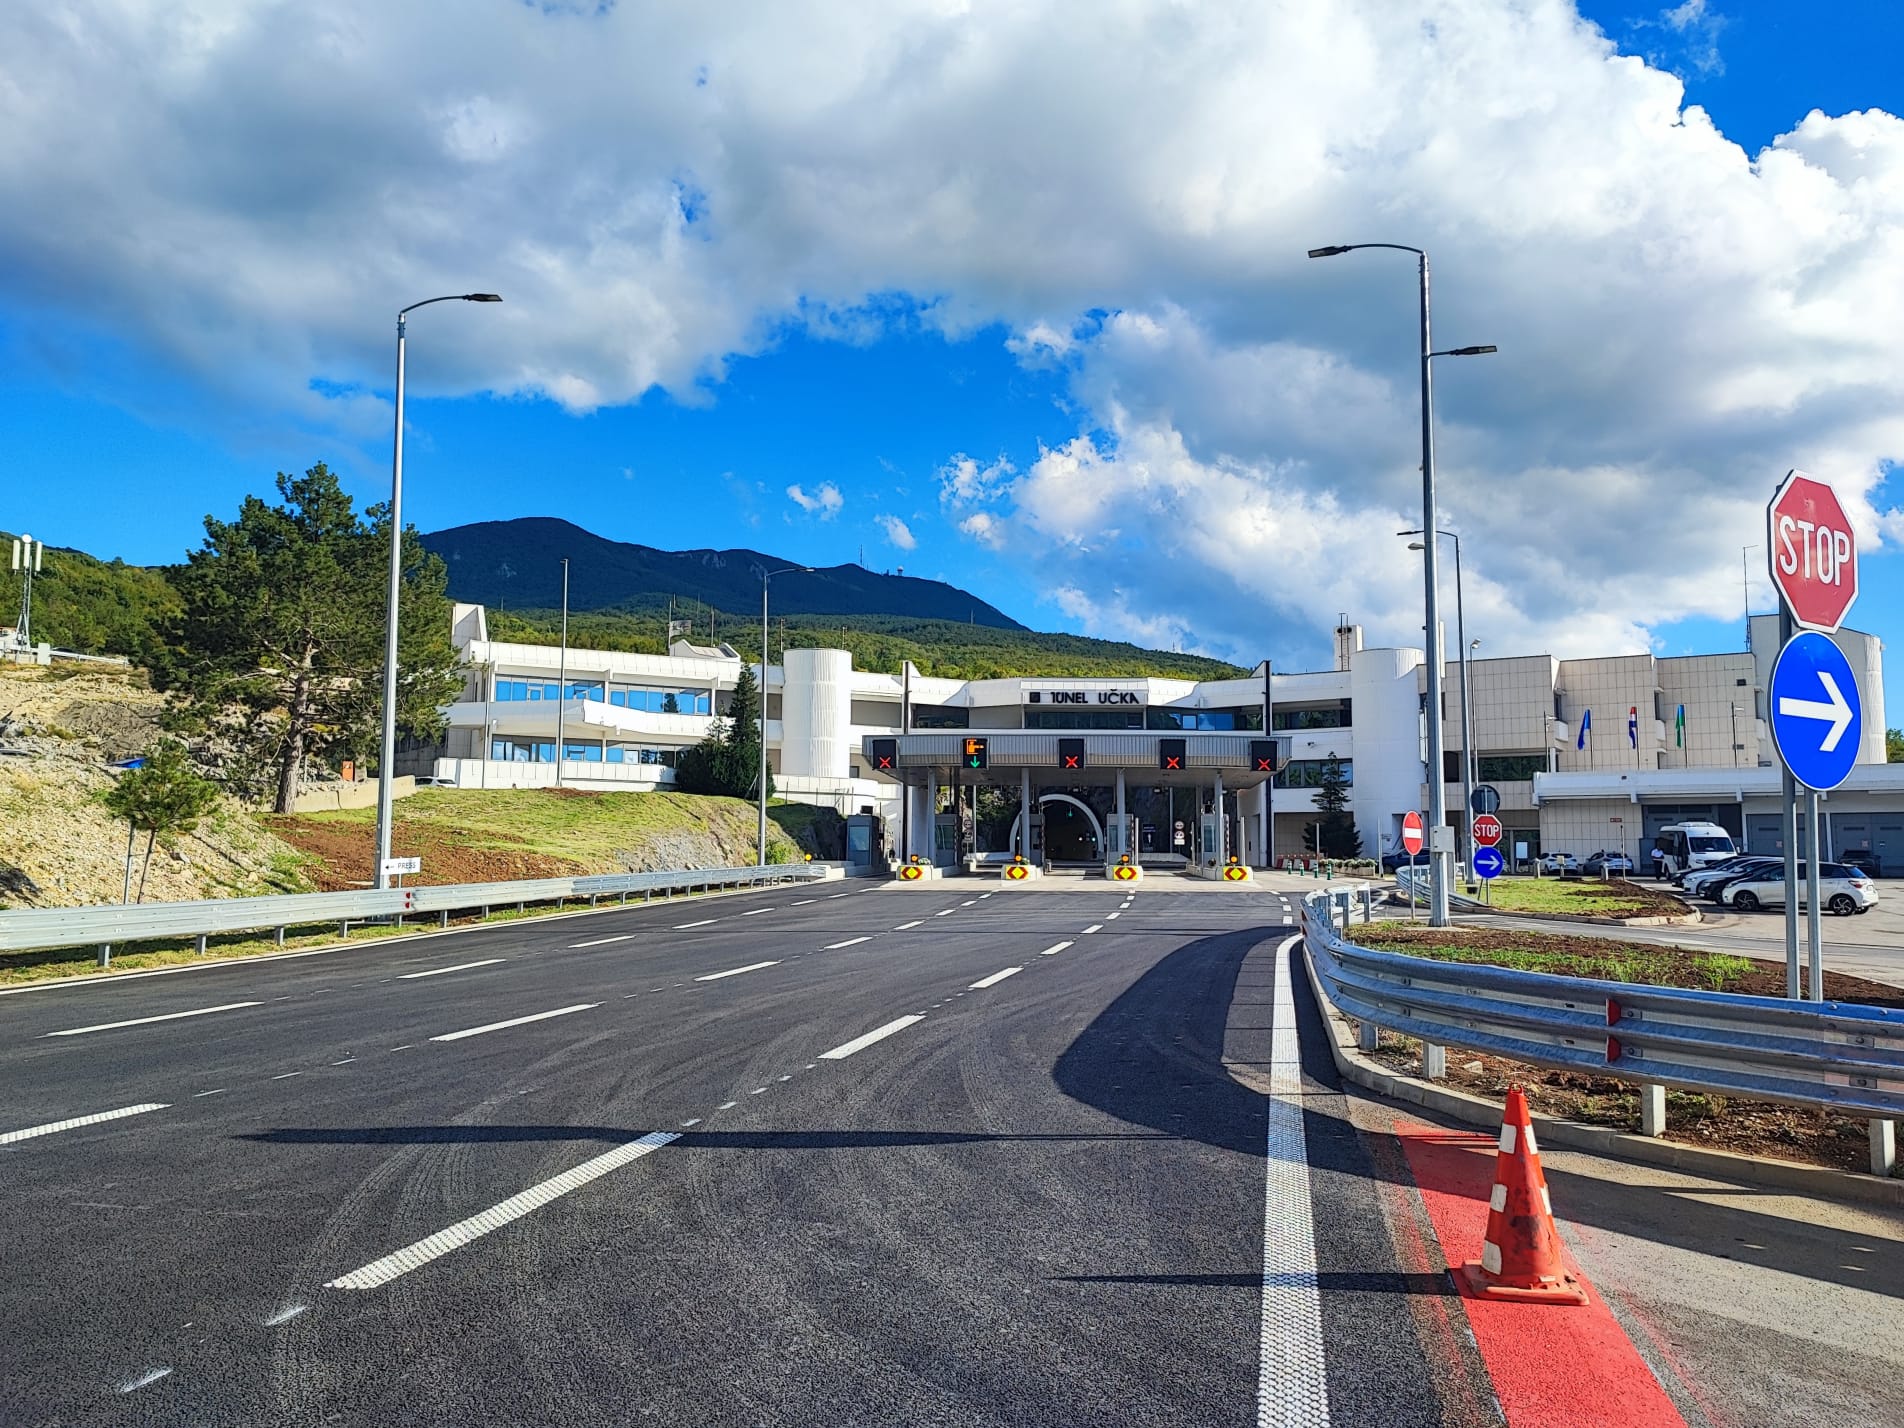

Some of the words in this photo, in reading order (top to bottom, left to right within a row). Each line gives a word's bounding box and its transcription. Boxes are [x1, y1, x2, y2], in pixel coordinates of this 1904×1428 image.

[1779, 515, 1850, 586] STOP
[1050, 691, 1088, 704] TUNEL
[1099, 689, 1139, 704] UČKA
[1474, 824, 1500, 838] STOP
[397, 861, 416, 869] PRESS
